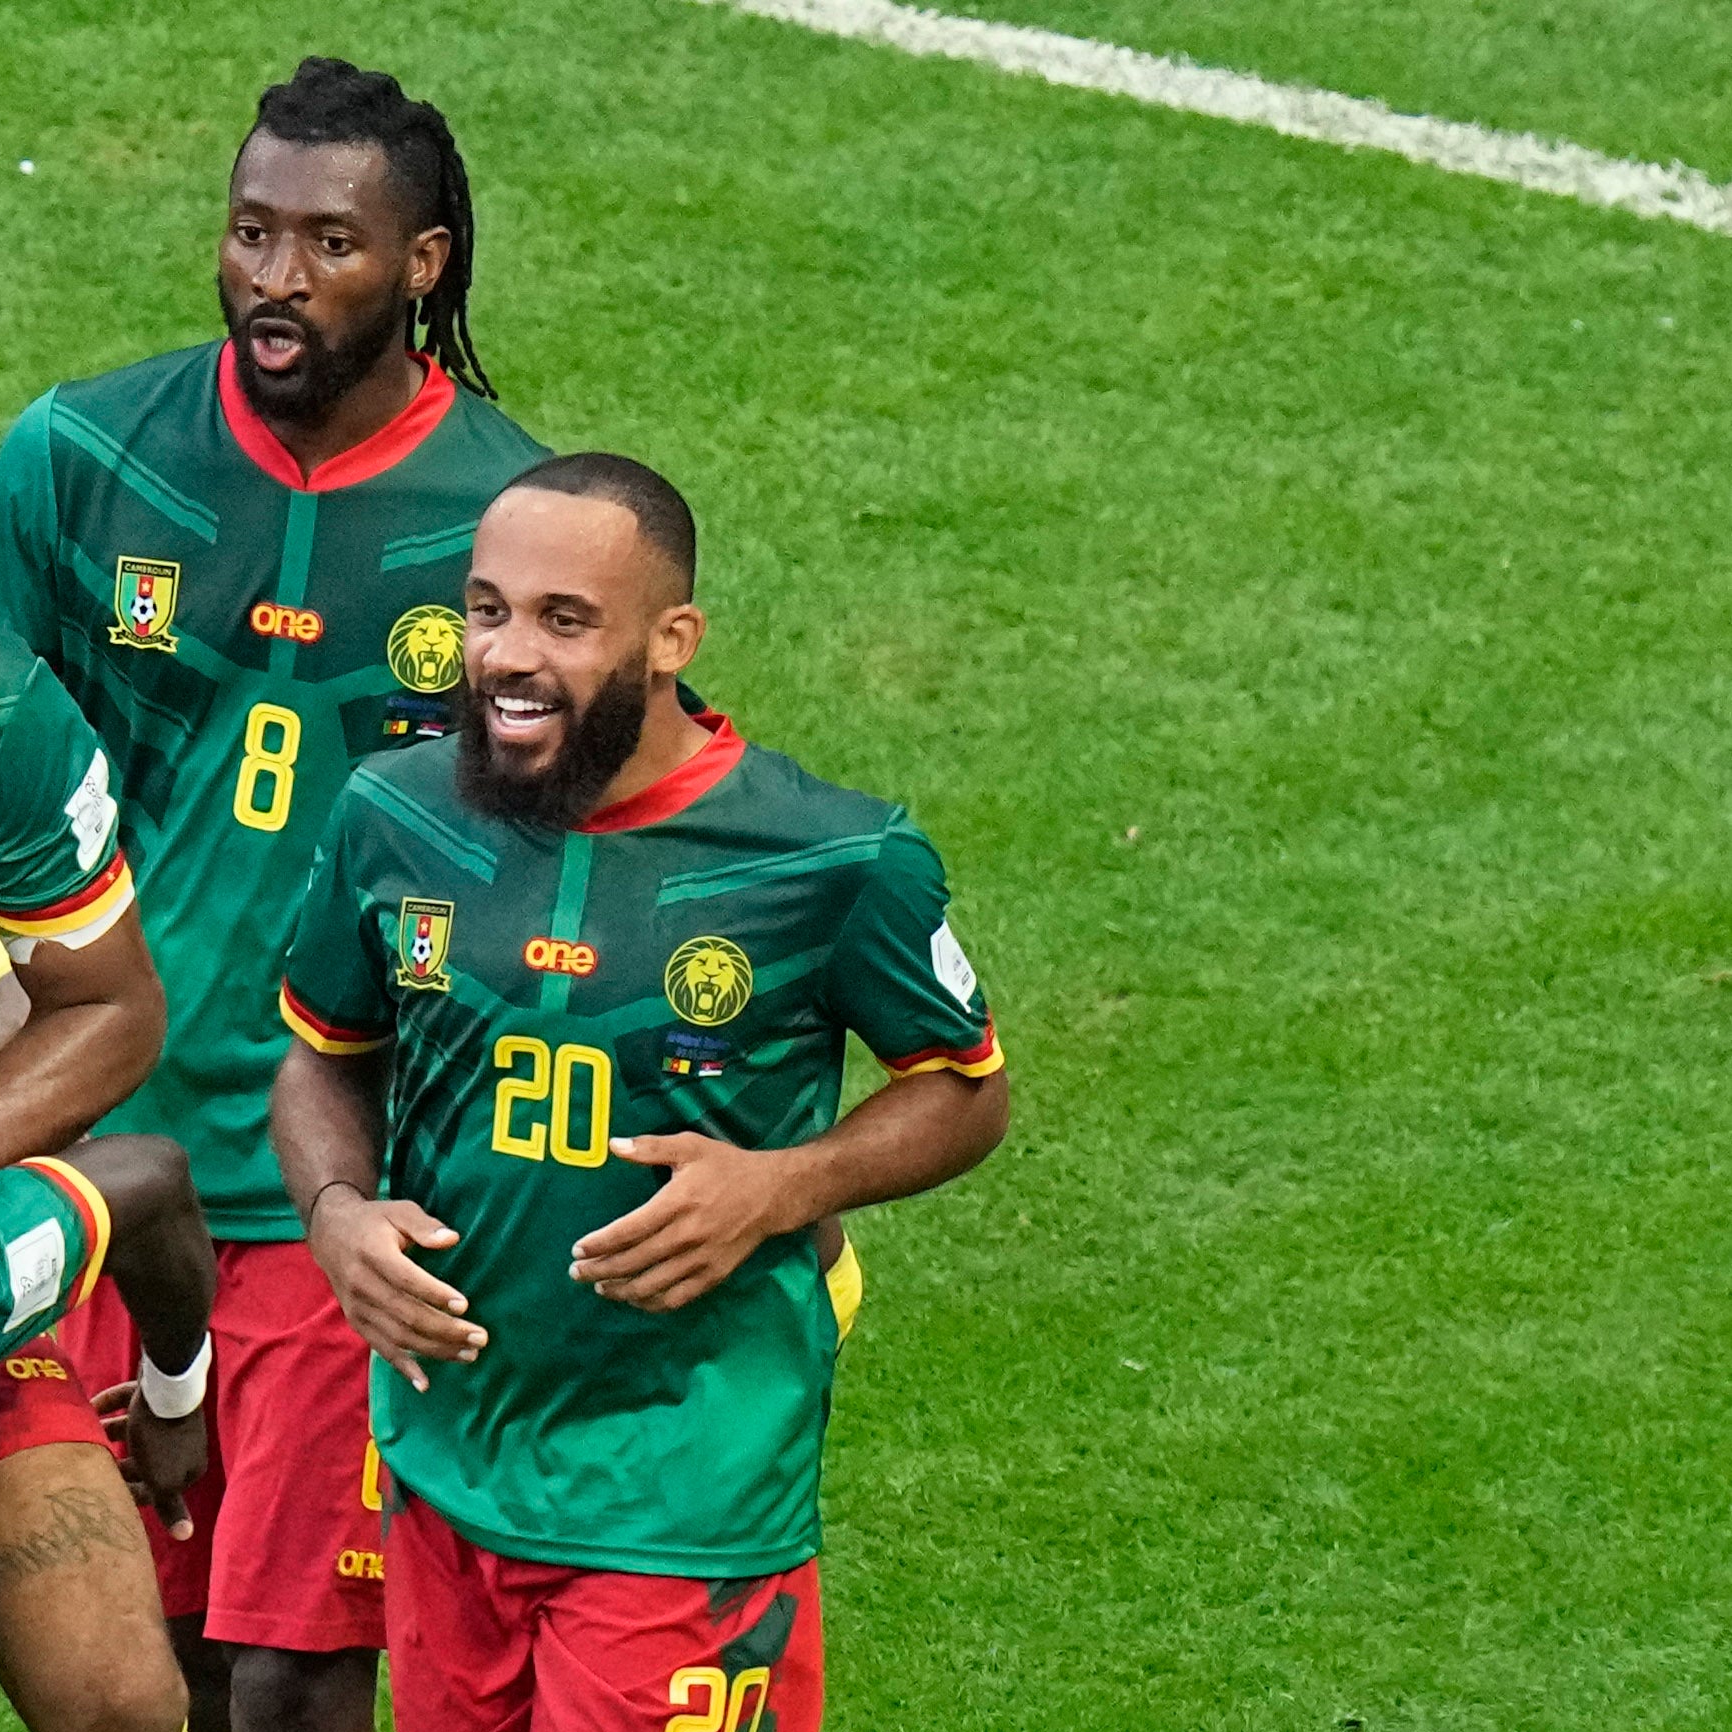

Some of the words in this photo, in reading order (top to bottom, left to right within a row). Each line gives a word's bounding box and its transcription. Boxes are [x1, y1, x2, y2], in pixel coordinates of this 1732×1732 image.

[252, 604, 320, 642] one
[233, 702, 302, 832] 8
[525, 939, 595, 973] one
[491, 1034, 613, 1169] 20
[5, 1357, 68, 1381] one
